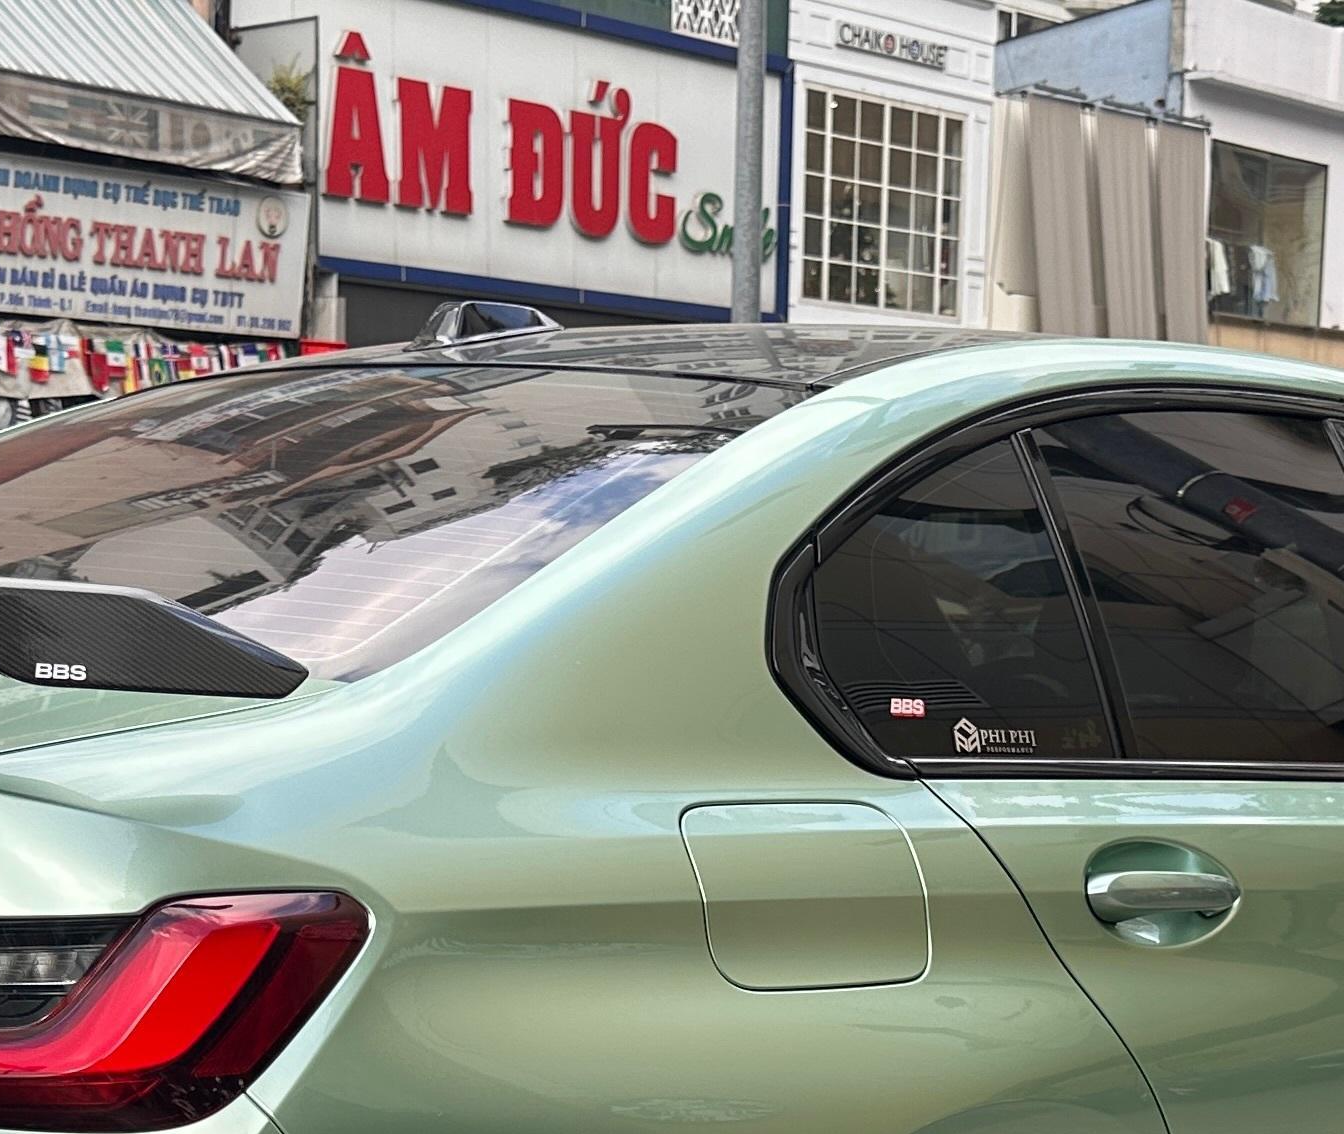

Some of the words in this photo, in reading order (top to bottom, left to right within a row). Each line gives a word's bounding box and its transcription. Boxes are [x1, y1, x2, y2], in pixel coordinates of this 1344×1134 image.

[898, 39, 948, 66] HOUSE
[321, 30, 473, 216] ÂM
[504, 79, 678, 247] ĐỨC
[90, 221, 207, 275] THANH
[215, 235, 281, 283] LAN
[35, 662, 88, 681] BBS
[890, 698, 925, 716] BBS
[980, 729, 1007, 745] PHI
